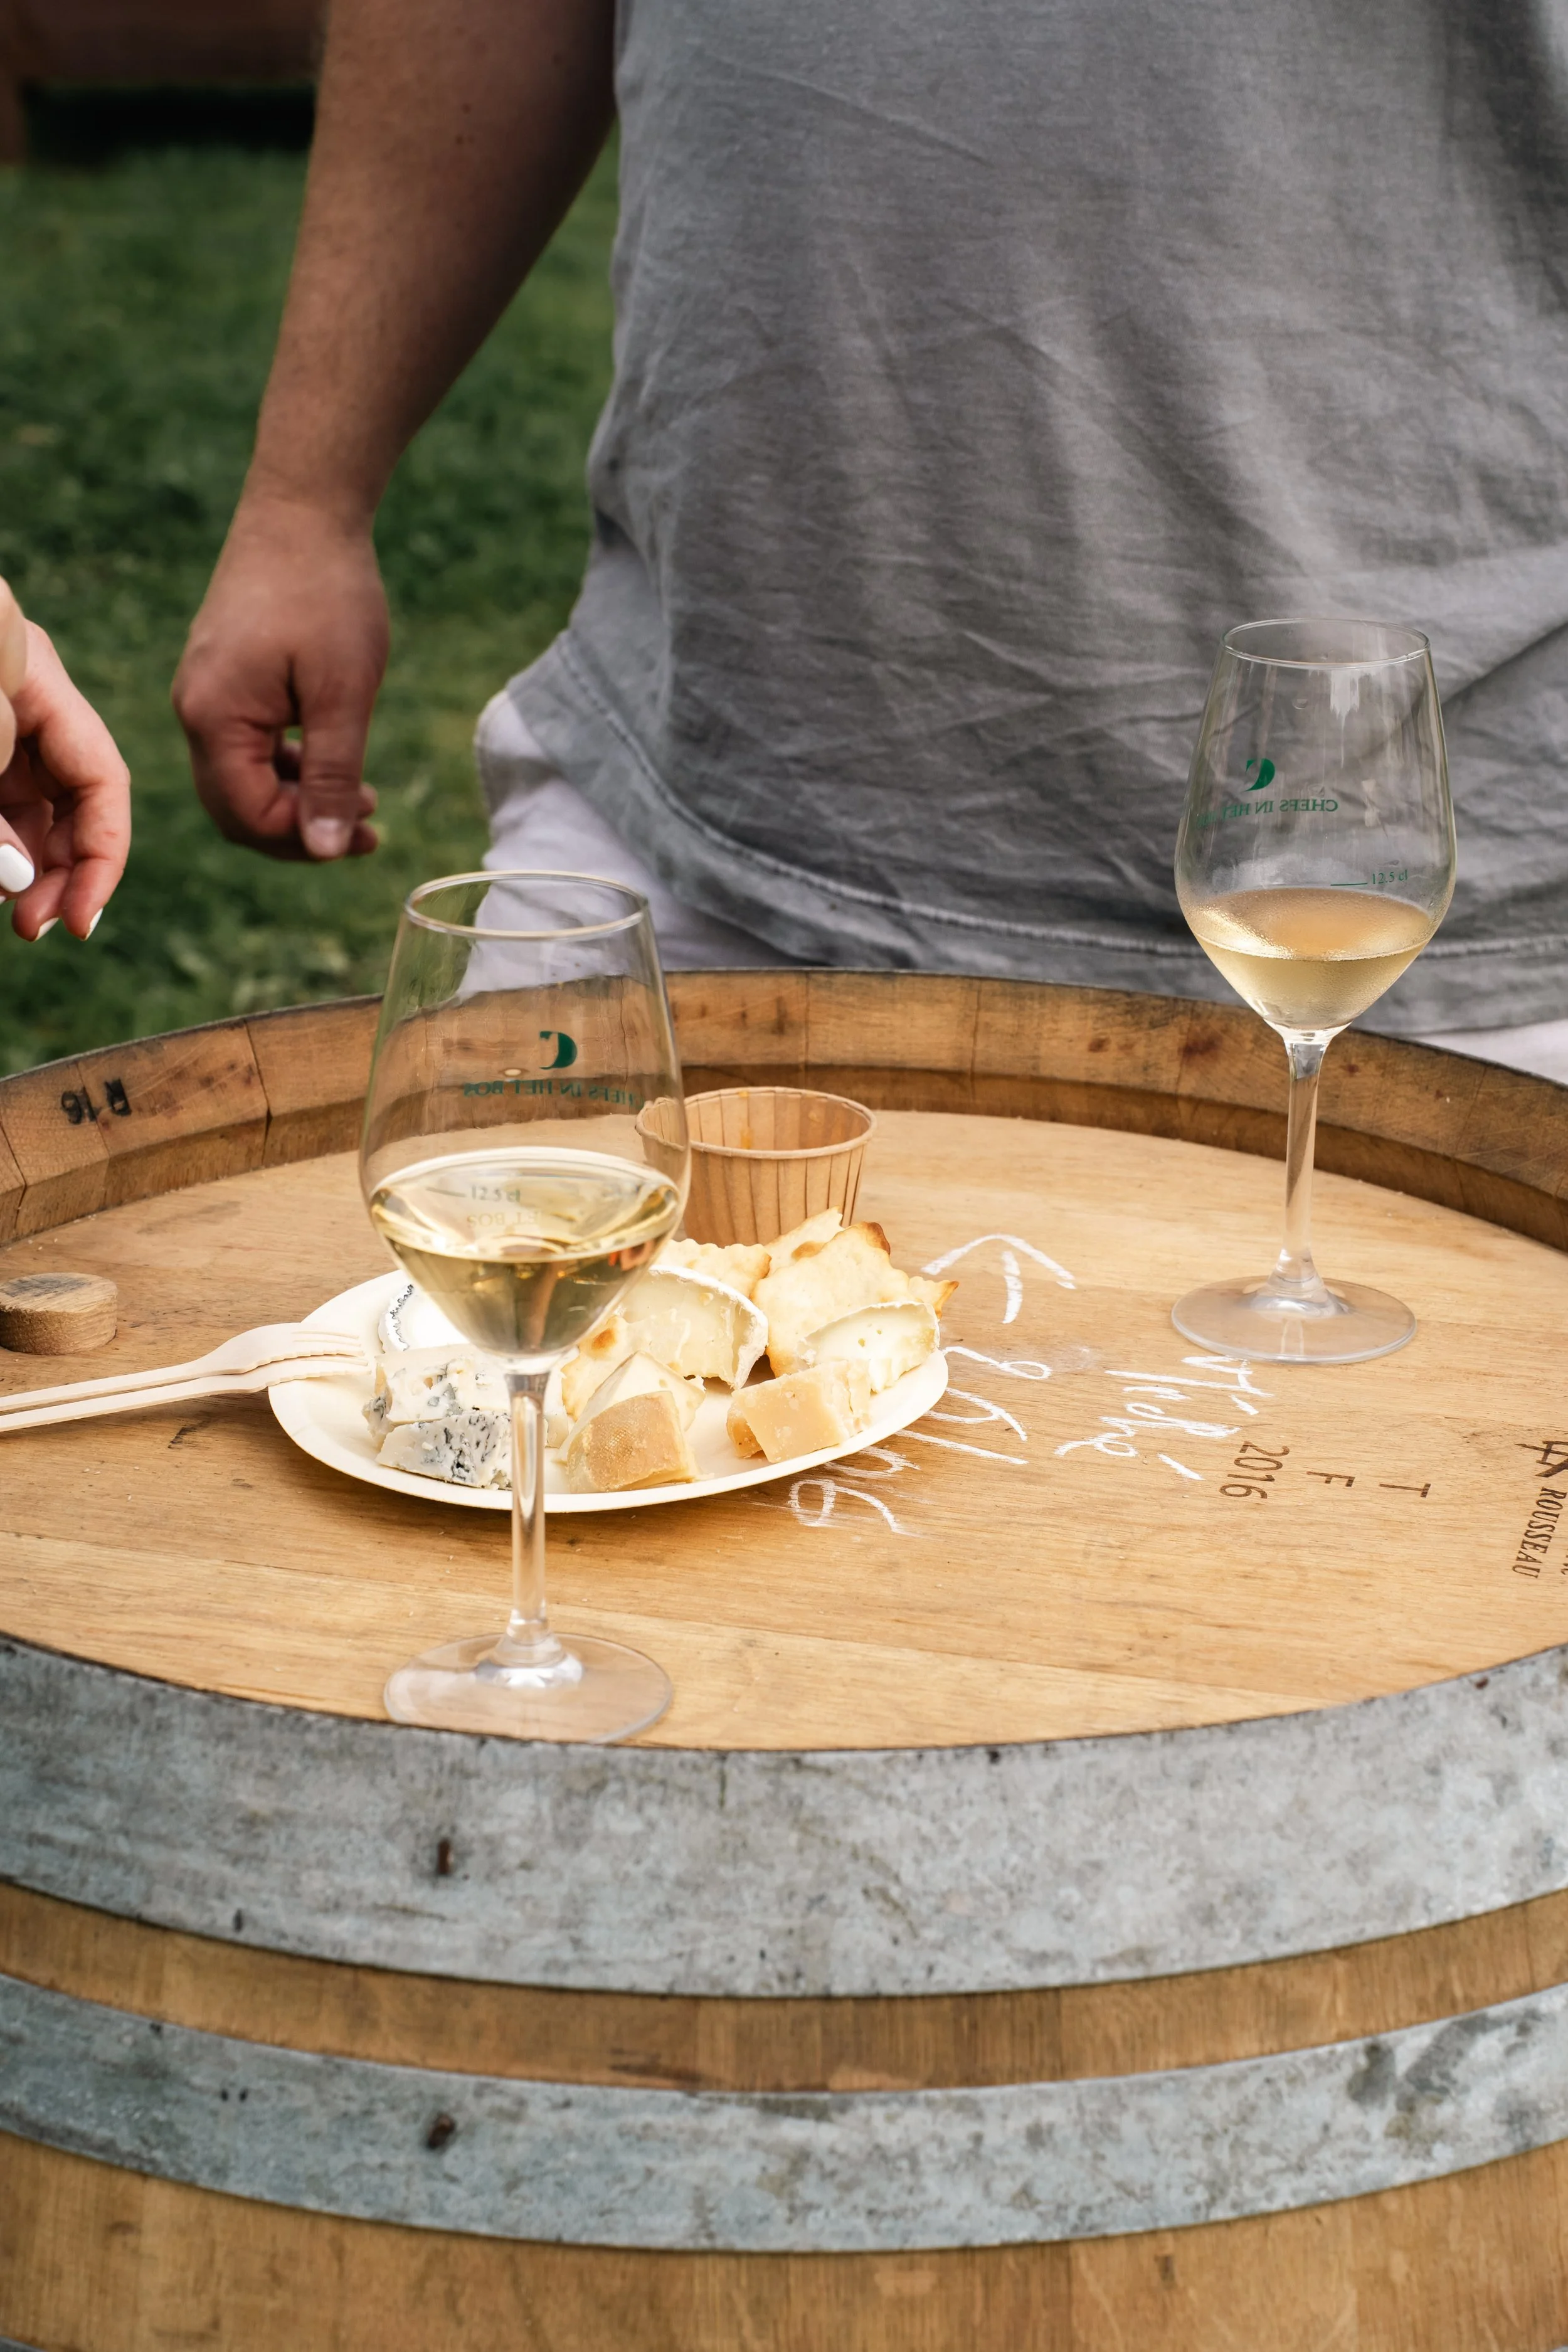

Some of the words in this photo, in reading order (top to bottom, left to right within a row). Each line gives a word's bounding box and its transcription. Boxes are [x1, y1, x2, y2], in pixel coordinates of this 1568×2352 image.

[1371, 871, 1395, 885] 12.5
[1398, 869, 1408, 881] cl
[1219, 1440, 1290, 1499] 2016
[1306, 1470, 1355, 1488] F
[1379, 1482, 1431, 1498] T
[1512, 1486, 1568, 1579] ROUSSEAU
